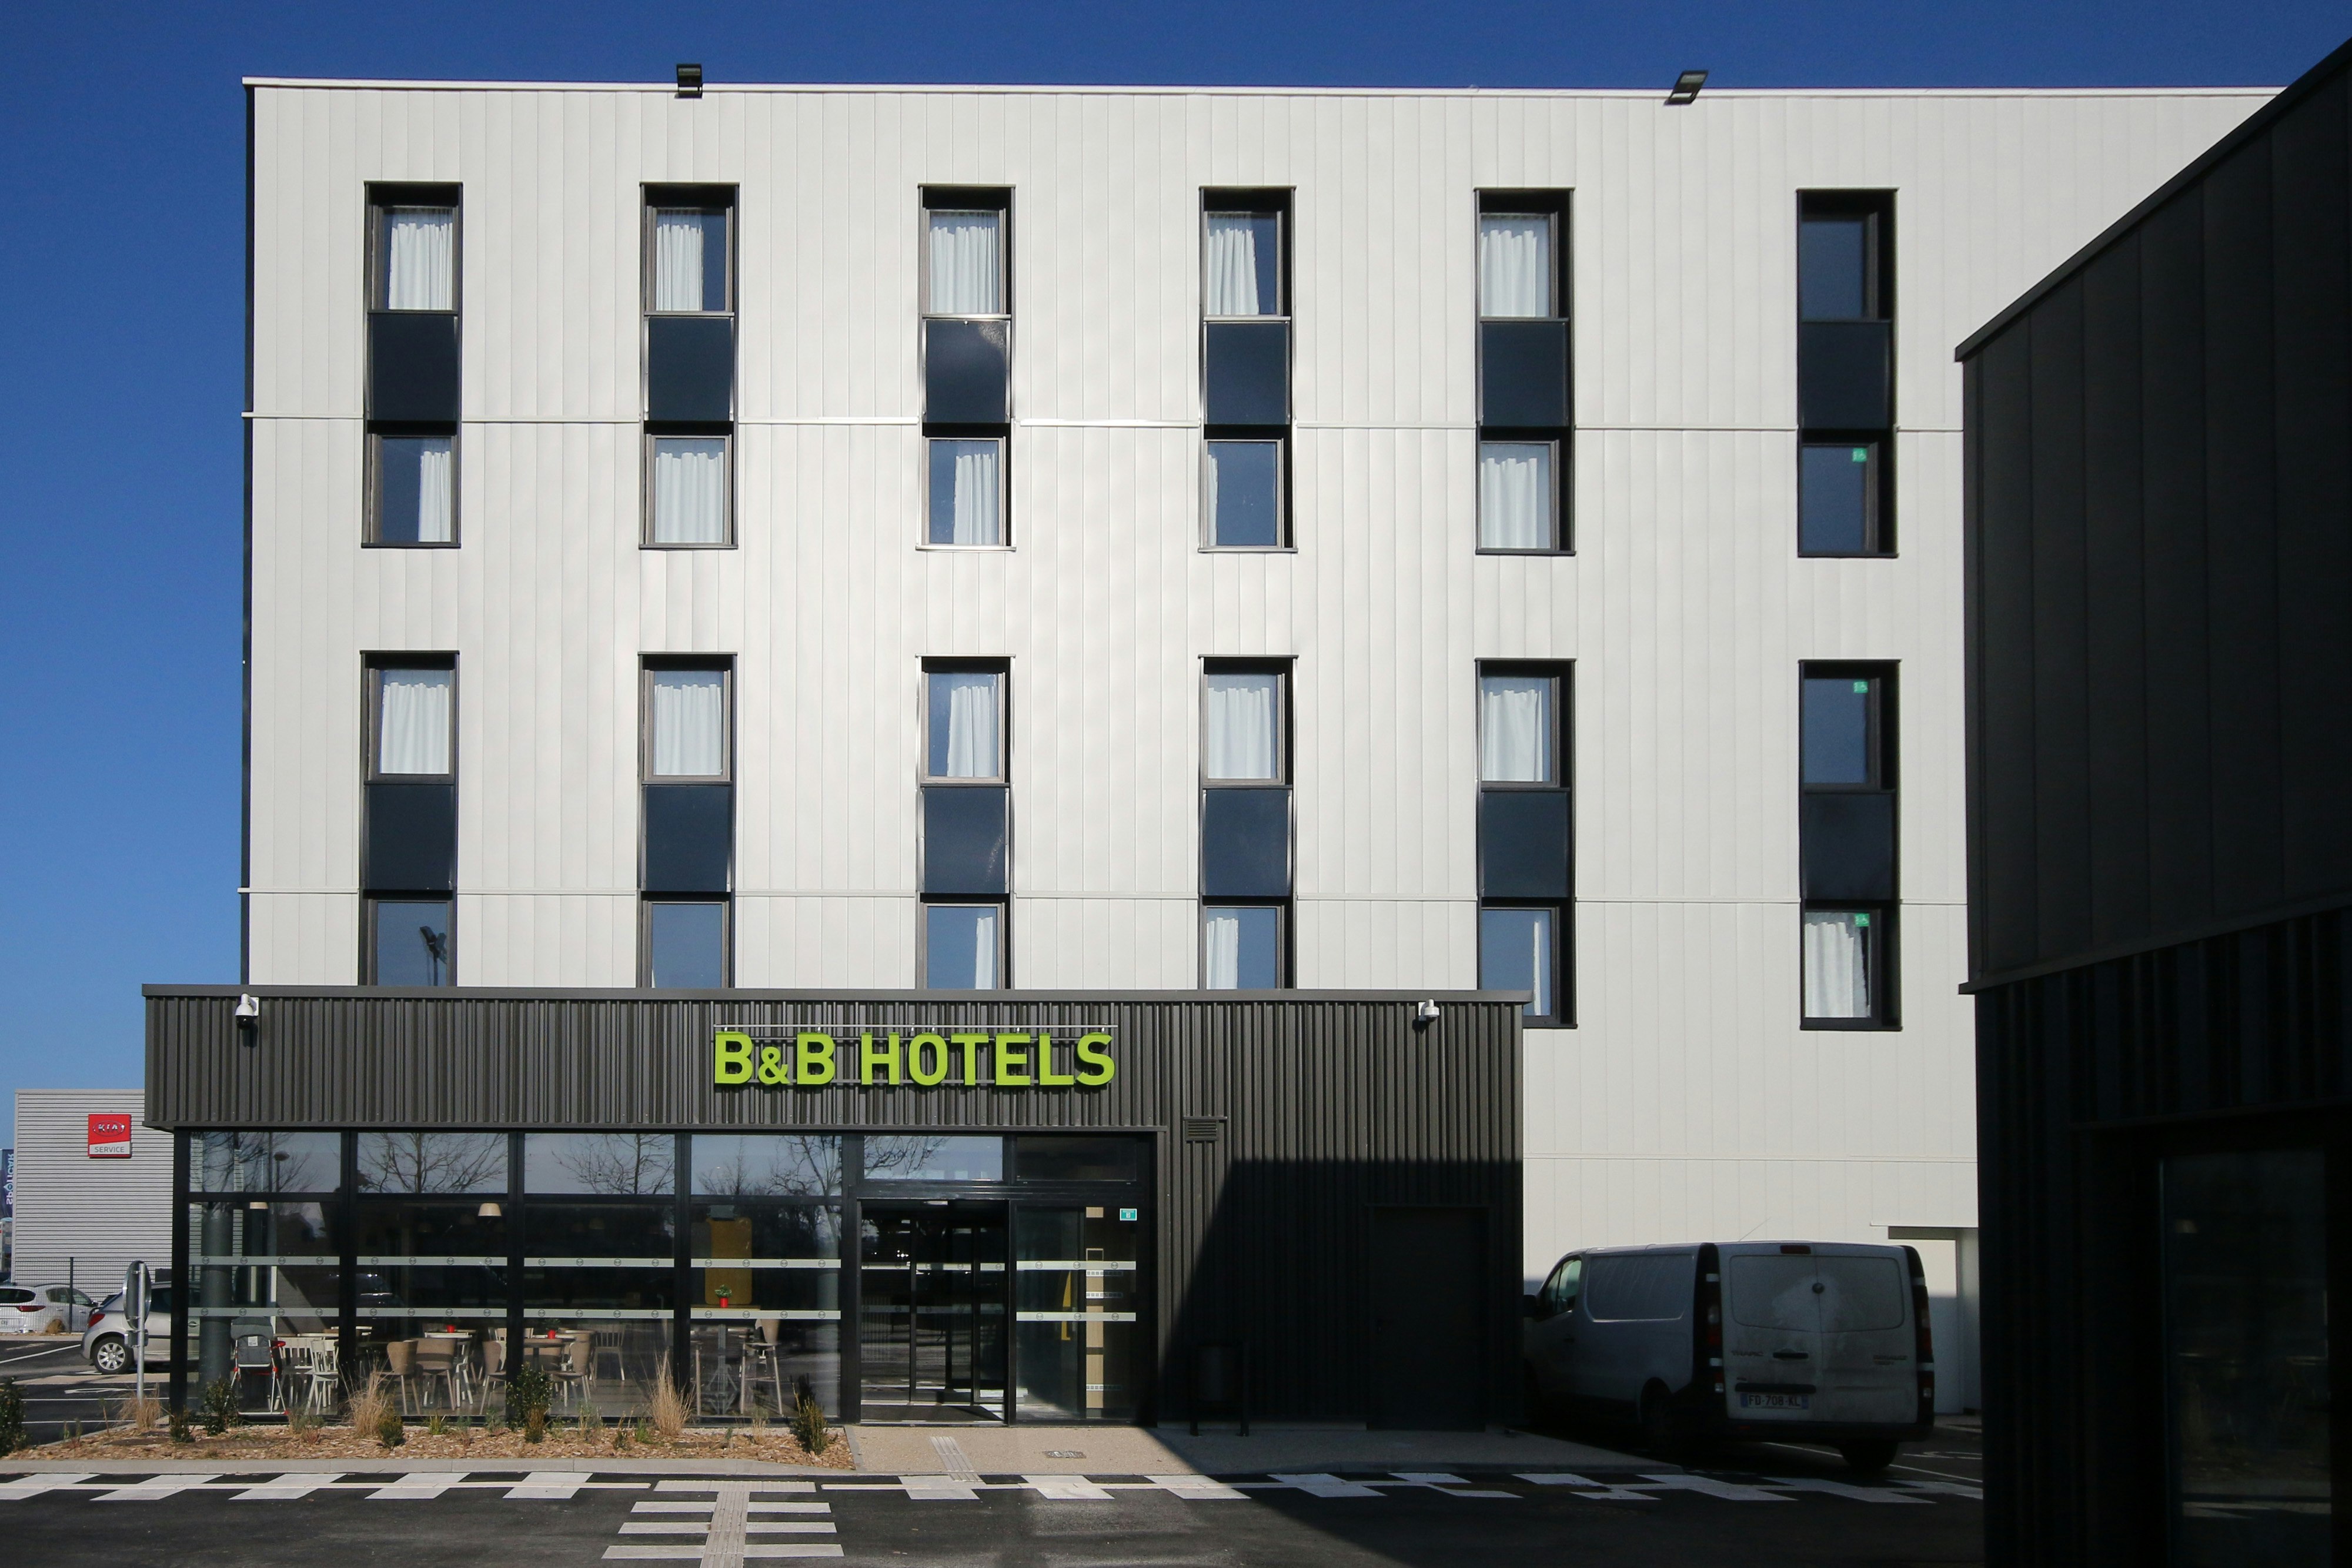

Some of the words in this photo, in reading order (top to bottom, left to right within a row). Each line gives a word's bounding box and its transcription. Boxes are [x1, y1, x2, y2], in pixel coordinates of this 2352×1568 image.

[714, 1031, 835, 1085] B&B
[861, 1032, 1115, 1086] HOTELS
[98, 1124, 118, 1132] KIA
[1749, 1395, 1800, 1406] FD-708-KL
